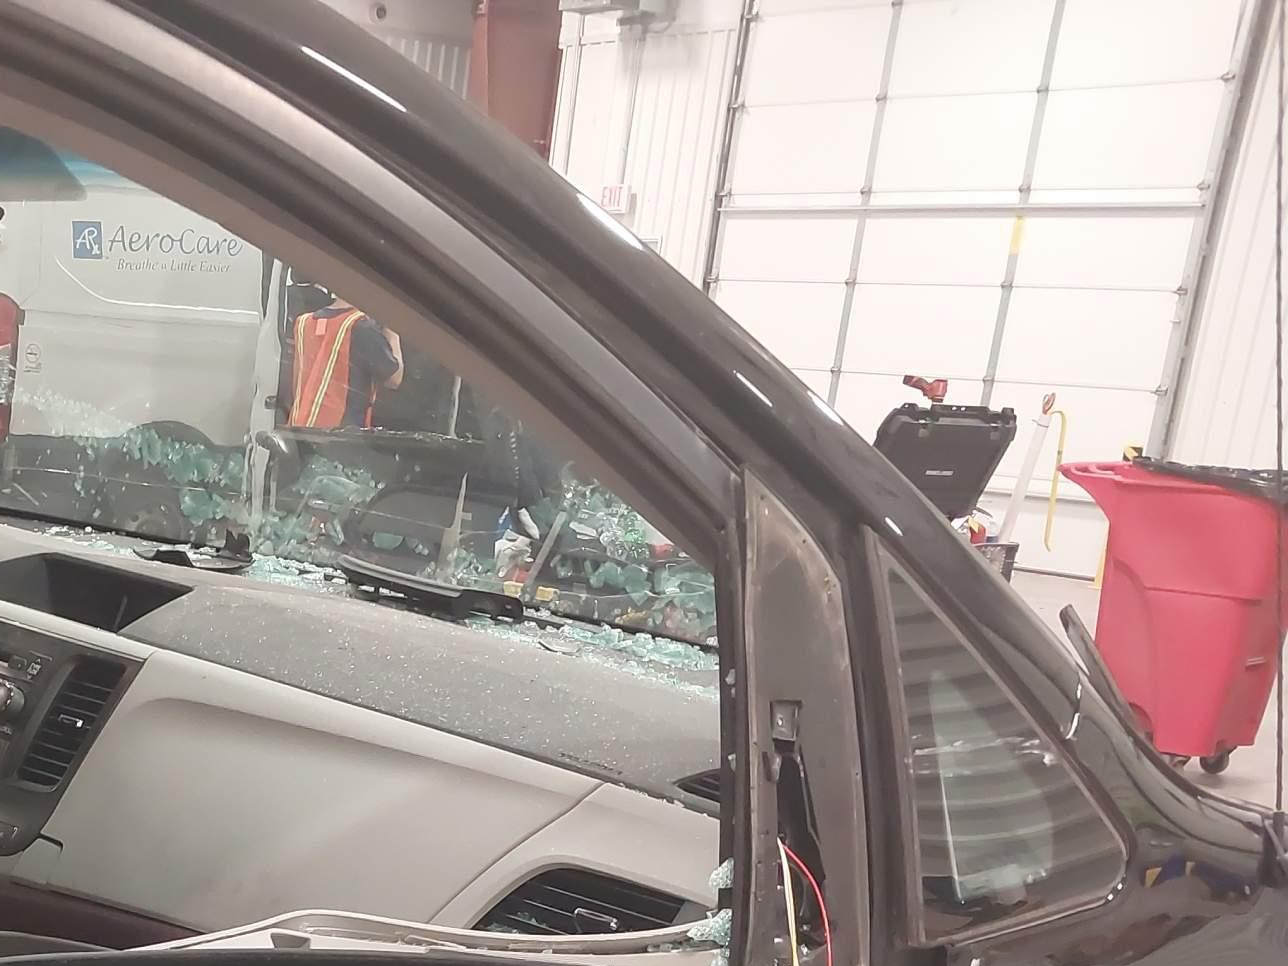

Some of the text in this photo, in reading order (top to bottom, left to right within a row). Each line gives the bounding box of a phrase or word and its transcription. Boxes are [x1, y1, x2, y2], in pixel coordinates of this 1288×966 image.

[601, 185, 623, 208] EXIT
[108, 225, 244, 257] AeroCare
[117, 258, 160, 271] Breathe
[170, 260, 197, 272] Little
[199, 261, 231, 273] Easier
